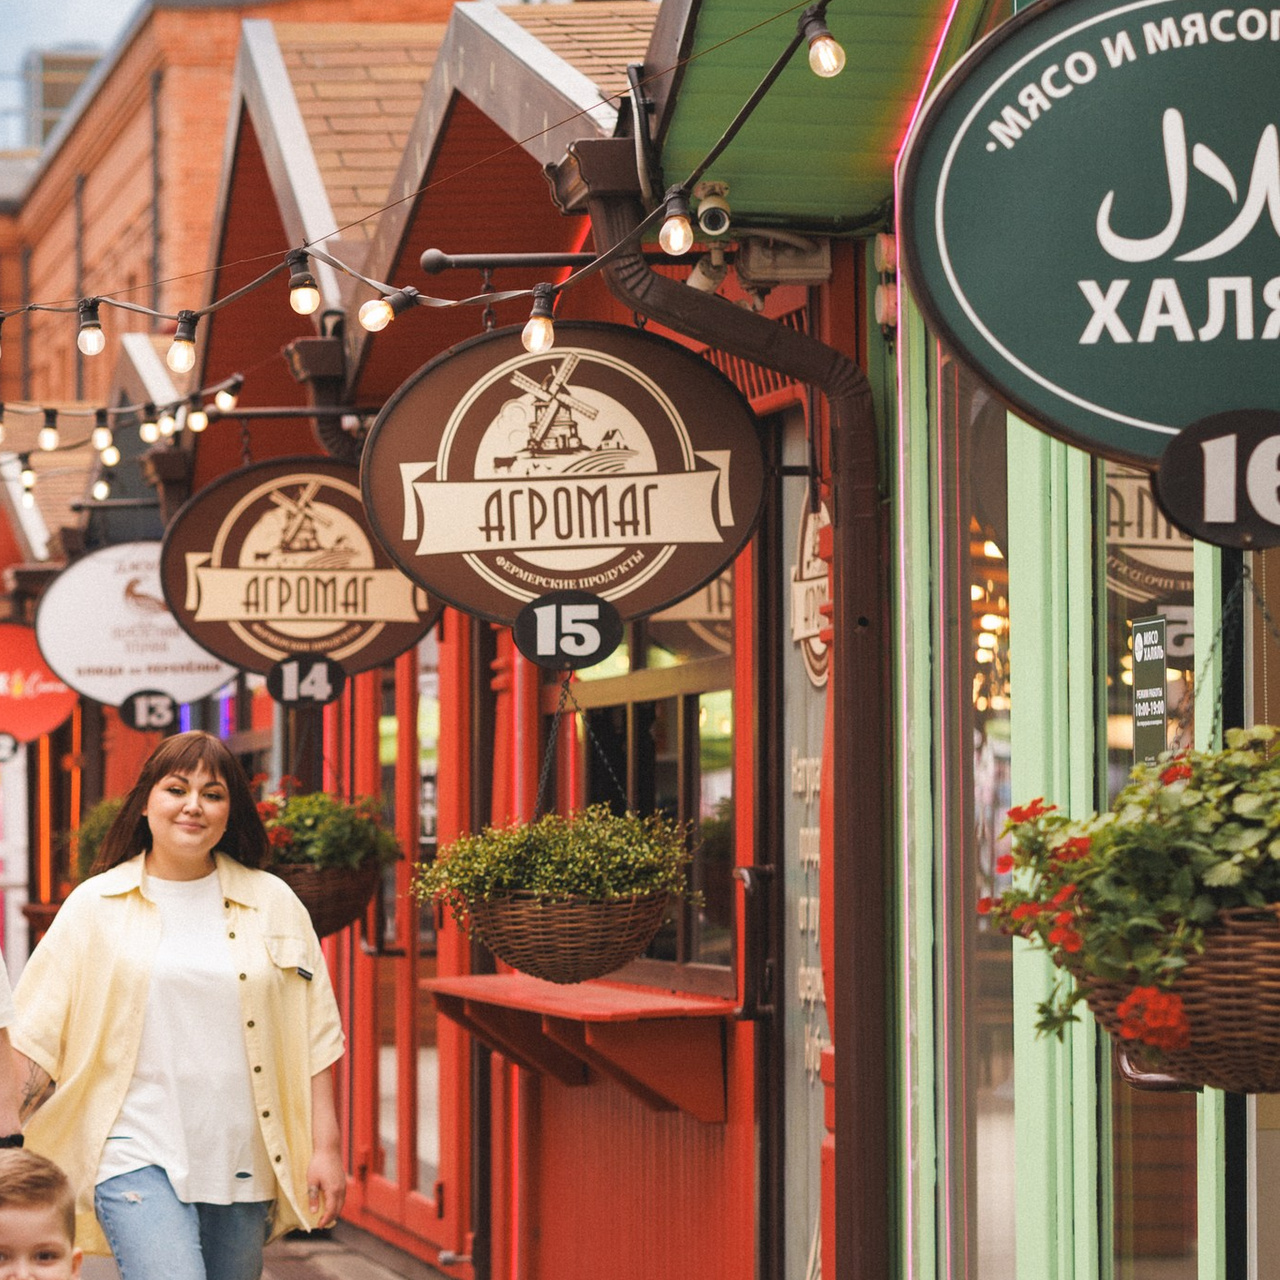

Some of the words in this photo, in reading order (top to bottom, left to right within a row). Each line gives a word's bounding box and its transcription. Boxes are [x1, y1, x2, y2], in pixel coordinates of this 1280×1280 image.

[987, 51, 1098, 150] МЯСО
[1100, 30, 1137, 68] И
[477, 482, 659, 543] АГРОМАГ
[495, 554, 578, 591] ФЕРМЕРСКИЕ
[579, 549, 646, 589] ПРОДУКТЫ
[242, 575, 374, 615] АГРОМАГ
[533, 603, 602, 657] 15
[1143, 629, 1159, 645] МЯСО
[282, 660, 333, 702] 14
[133, 695, 174, 728] 13
